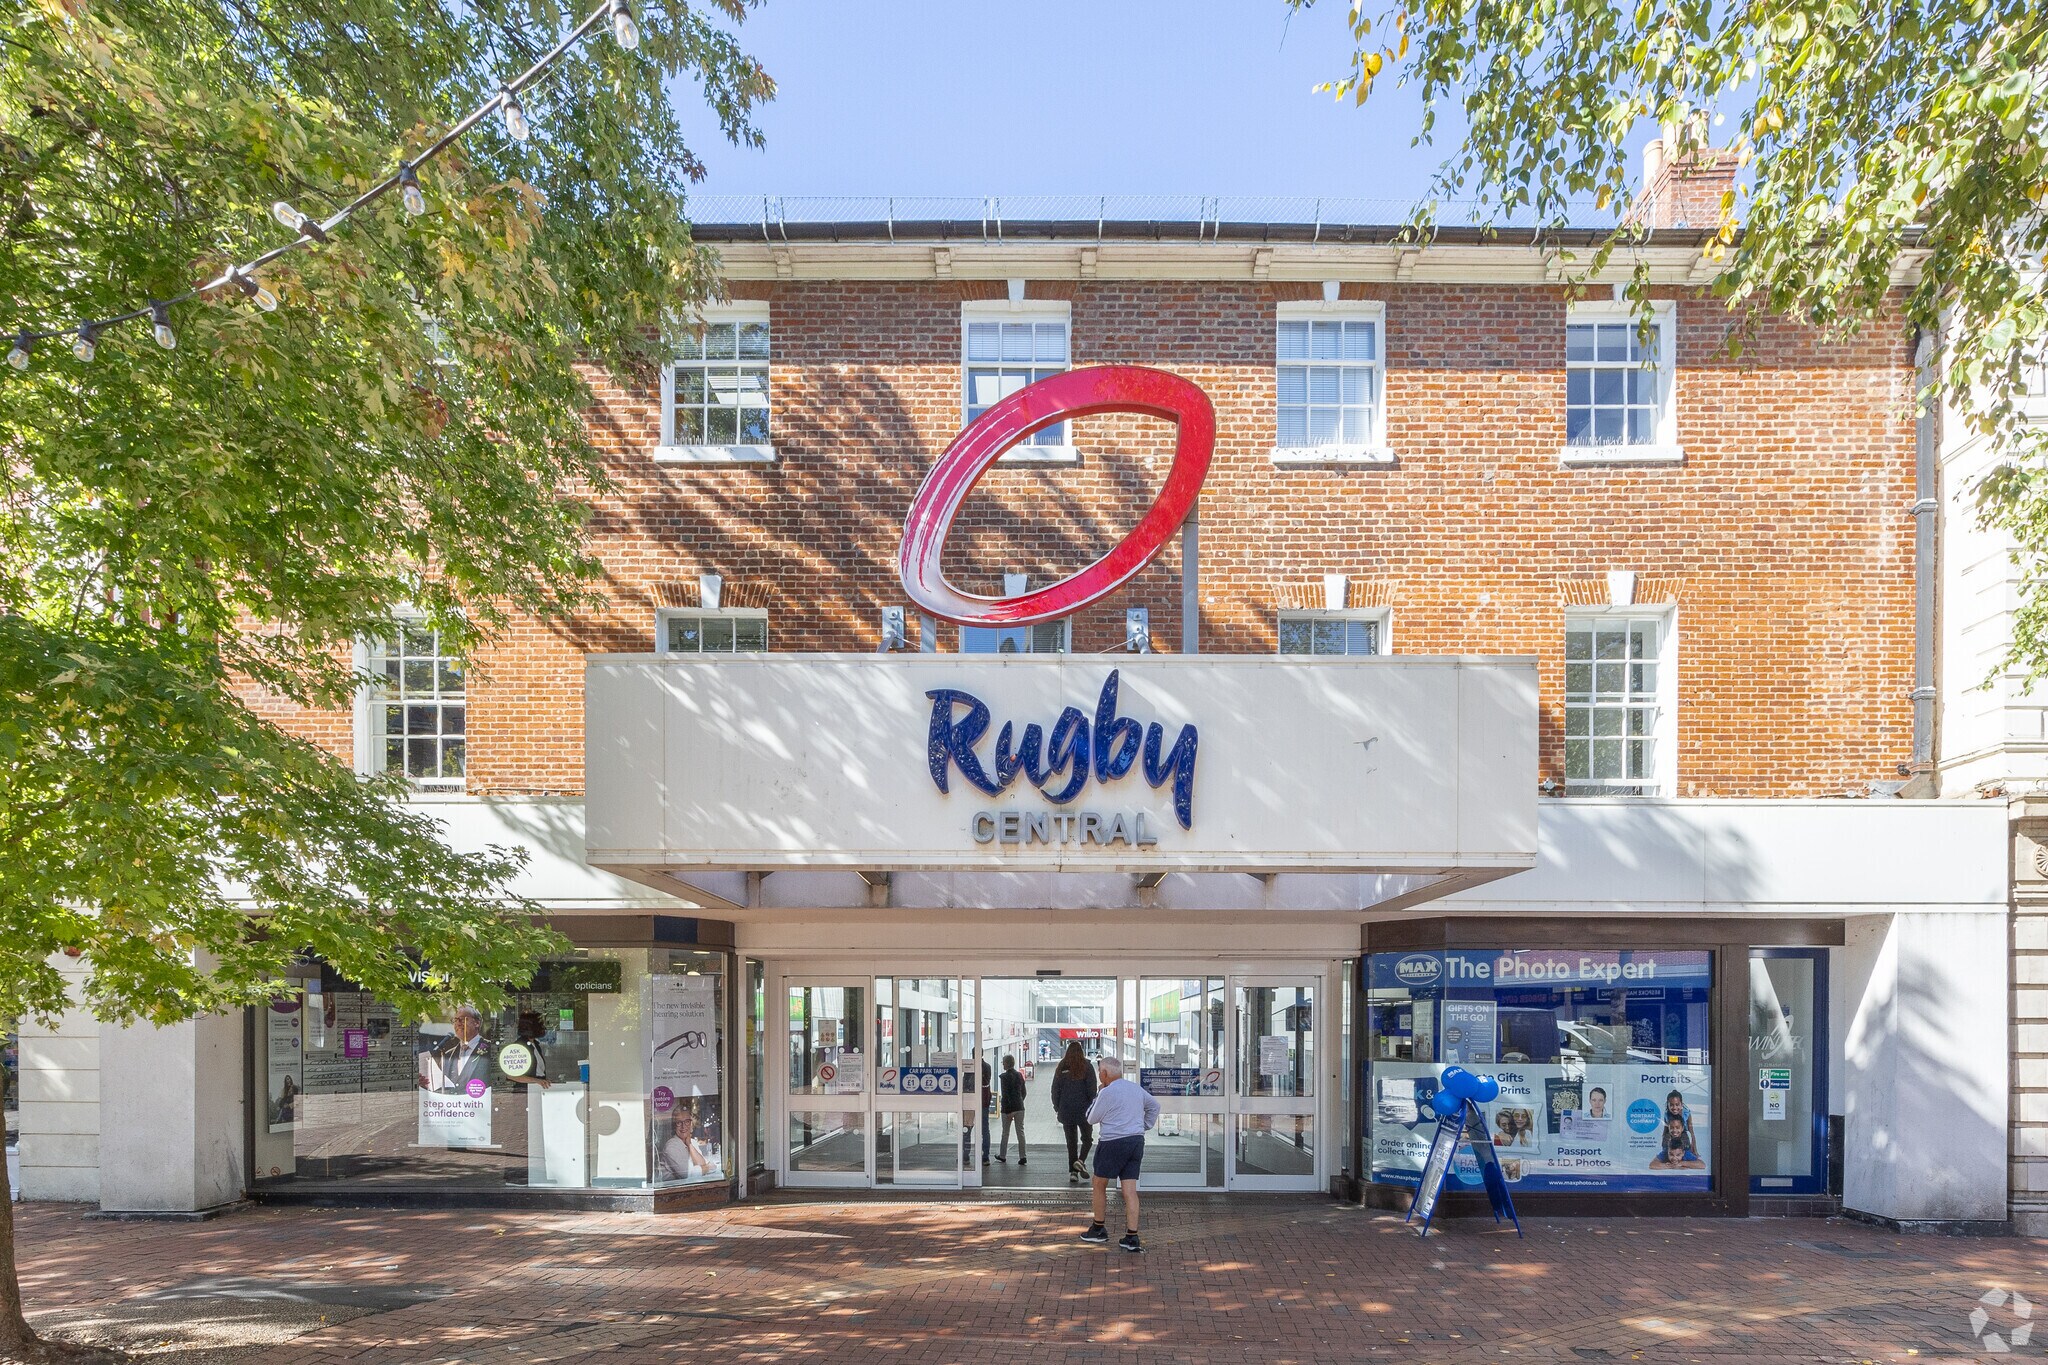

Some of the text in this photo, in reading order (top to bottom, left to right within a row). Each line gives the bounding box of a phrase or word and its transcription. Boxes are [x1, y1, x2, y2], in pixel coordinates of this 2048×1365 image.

[925, 669, 1198, 831] Rugby
[972, 811, 1158, 846] CENTRAL
[1399, 961, 1437, 974] MAX
[1446, 956, 1657, 984] The Photo Expert
[574, 982, 612, 991] opticians
[1448, 1005, 1489, 1013] GIFTS ON
[653, 1010, 705, 1019] hearing solution
[1450, 1013, 1487, 1022] THE GO!
[1075, 1029, 1099, 1038] wilko
[1497, 1073, 1524, 1083] Gifts
[1641, 1074, 1691, 1084] Portraits
[879, 1081, 896, 1089] Rugby
[907, 1079, 915, 1087] £1
[925, 1079, 933, 1087] £2
[943, 1079, 951, 1087] £1
[1500, 1086, 1531, 1095] Prints
[423, 1100, 484, 1110] Step out with
[423, 1109, 475, 1118] confidence
[1380, 1138, 1404, 1148] Order
[1378, 1146, 1405, 1156] collect
[1407, 1148, 1429, 1158] in-st
[1557, 1147, 1602, 1157] Passport
[1460, 1159, 1479, 1167] HAL
[1547, 1158, 1611, 1167] & I.D. Photos
